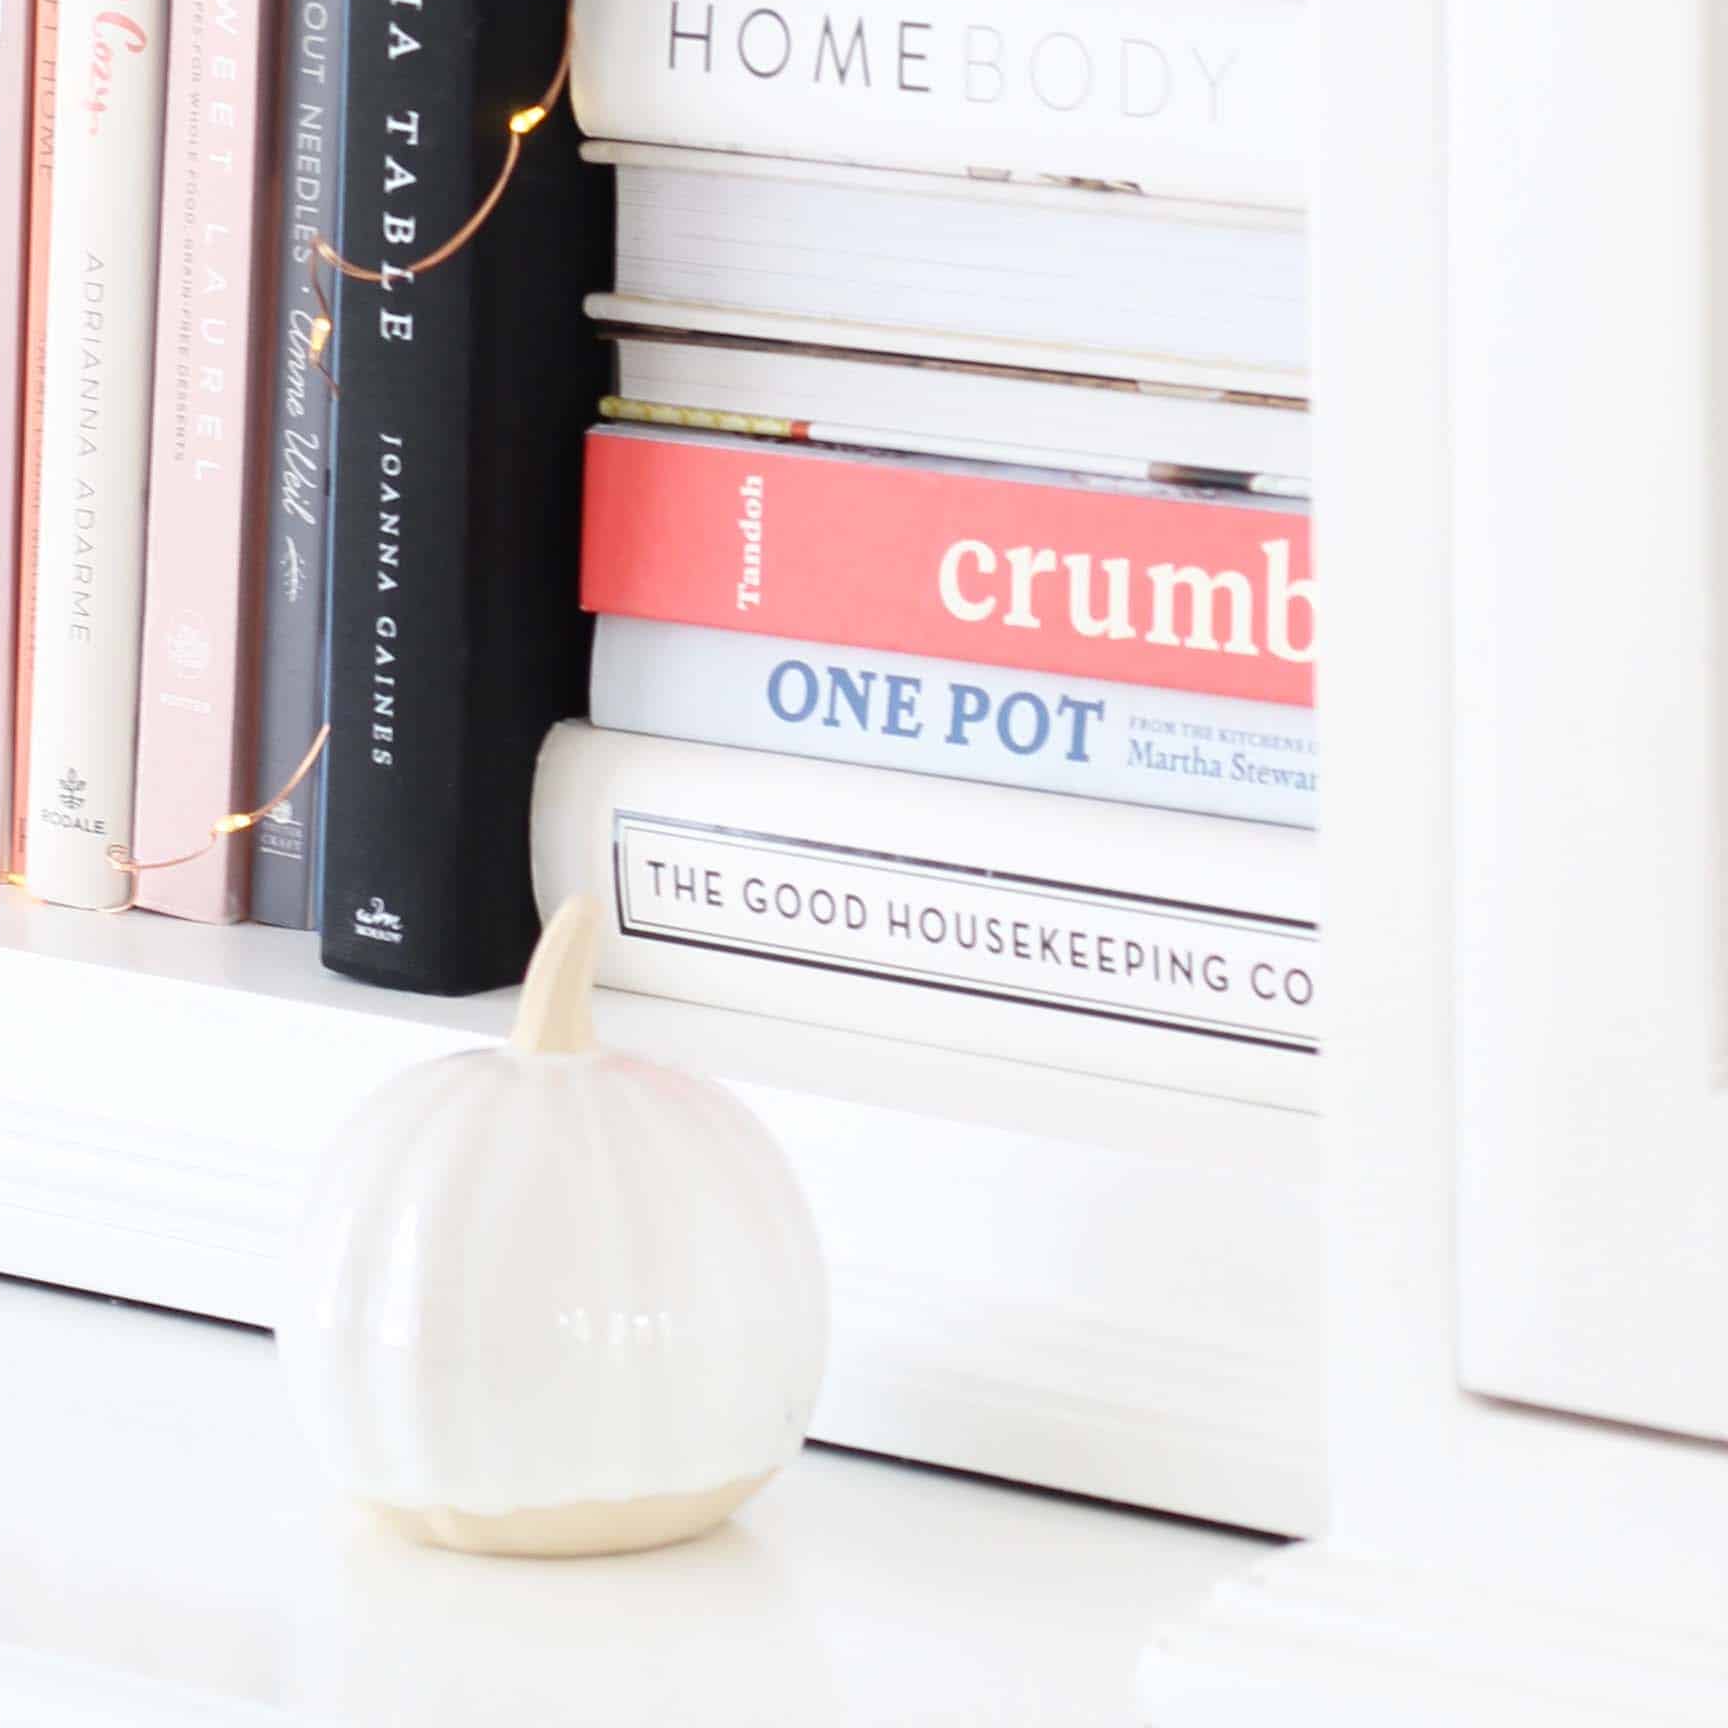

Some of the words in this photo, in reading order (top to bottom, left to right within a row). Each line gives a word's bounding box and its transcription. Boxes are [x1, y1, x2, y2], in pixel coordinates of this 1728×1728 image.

[288, 103, 323, 264] NEEDLES
[379, 112, 420, 341] TABLE
[73, 251, 106, 458] ADRIANNA
[193, 223, 230, 481] LAUREL
[68, 479, 100, 642] ADARME
[376, 433, 404, 593] JOANNA
[738, 474, 765, 611] Tandoh
[371, 614, 399, 766] GAINES
[765, 658, 923, 739] ONE
[943, 681, 1105, 765] POT
[1127, 739, 1222, 778] Martha
[1128, 715, 1176, 734] FROM
[1182, 723, 1213, 740] THE
[1218, 729, 1304, 752] KITCHENS
[648, 861, 725, 907] THE
[743, 879, 868, 931] GOOD
[887, 899, 1230, 993] HOUSEKEEPING
[1248, 965, 1315, 1008] CO
